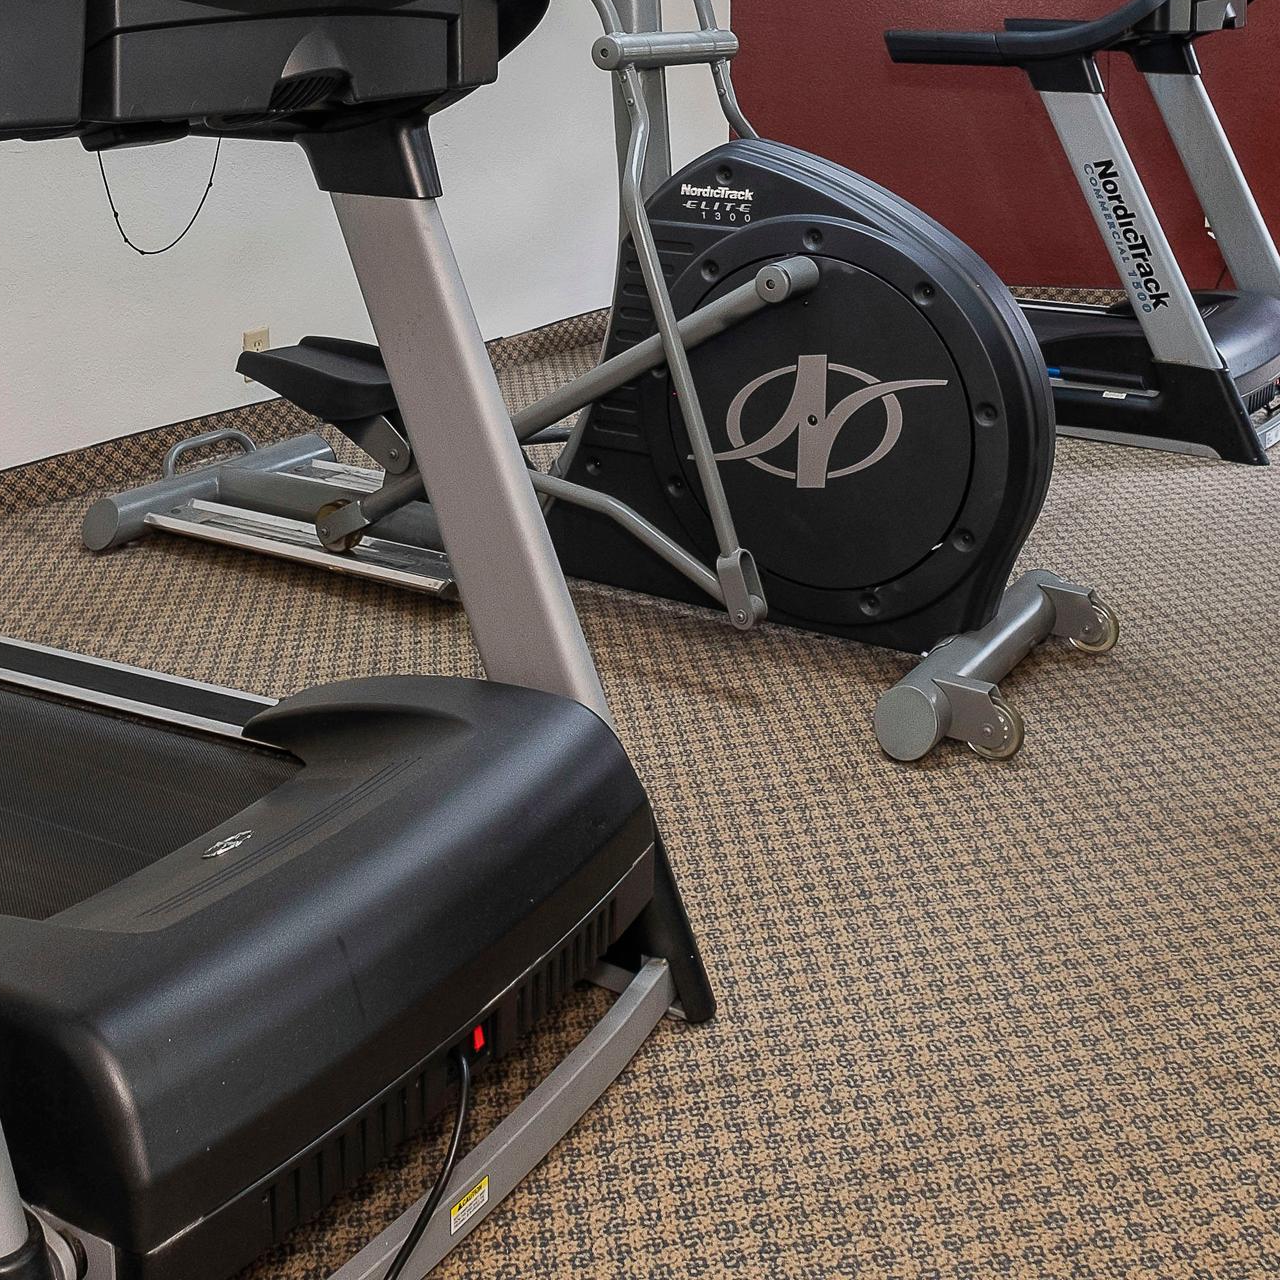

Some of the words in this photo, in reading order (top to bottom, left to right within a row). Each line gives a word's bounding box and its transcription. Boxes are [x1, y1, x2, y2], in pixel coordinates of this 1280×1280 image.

[680, 183, 754, 201] NordicTrack
[682, 200, 752, 213] ELITE
[701, 211, 751, 223] 1300
[1083, 163, 1130, 264] COMMERCIAL
[1127, 270, 1152, 314] 1500
[1093, 159, 1171, 310] NordicTrack
